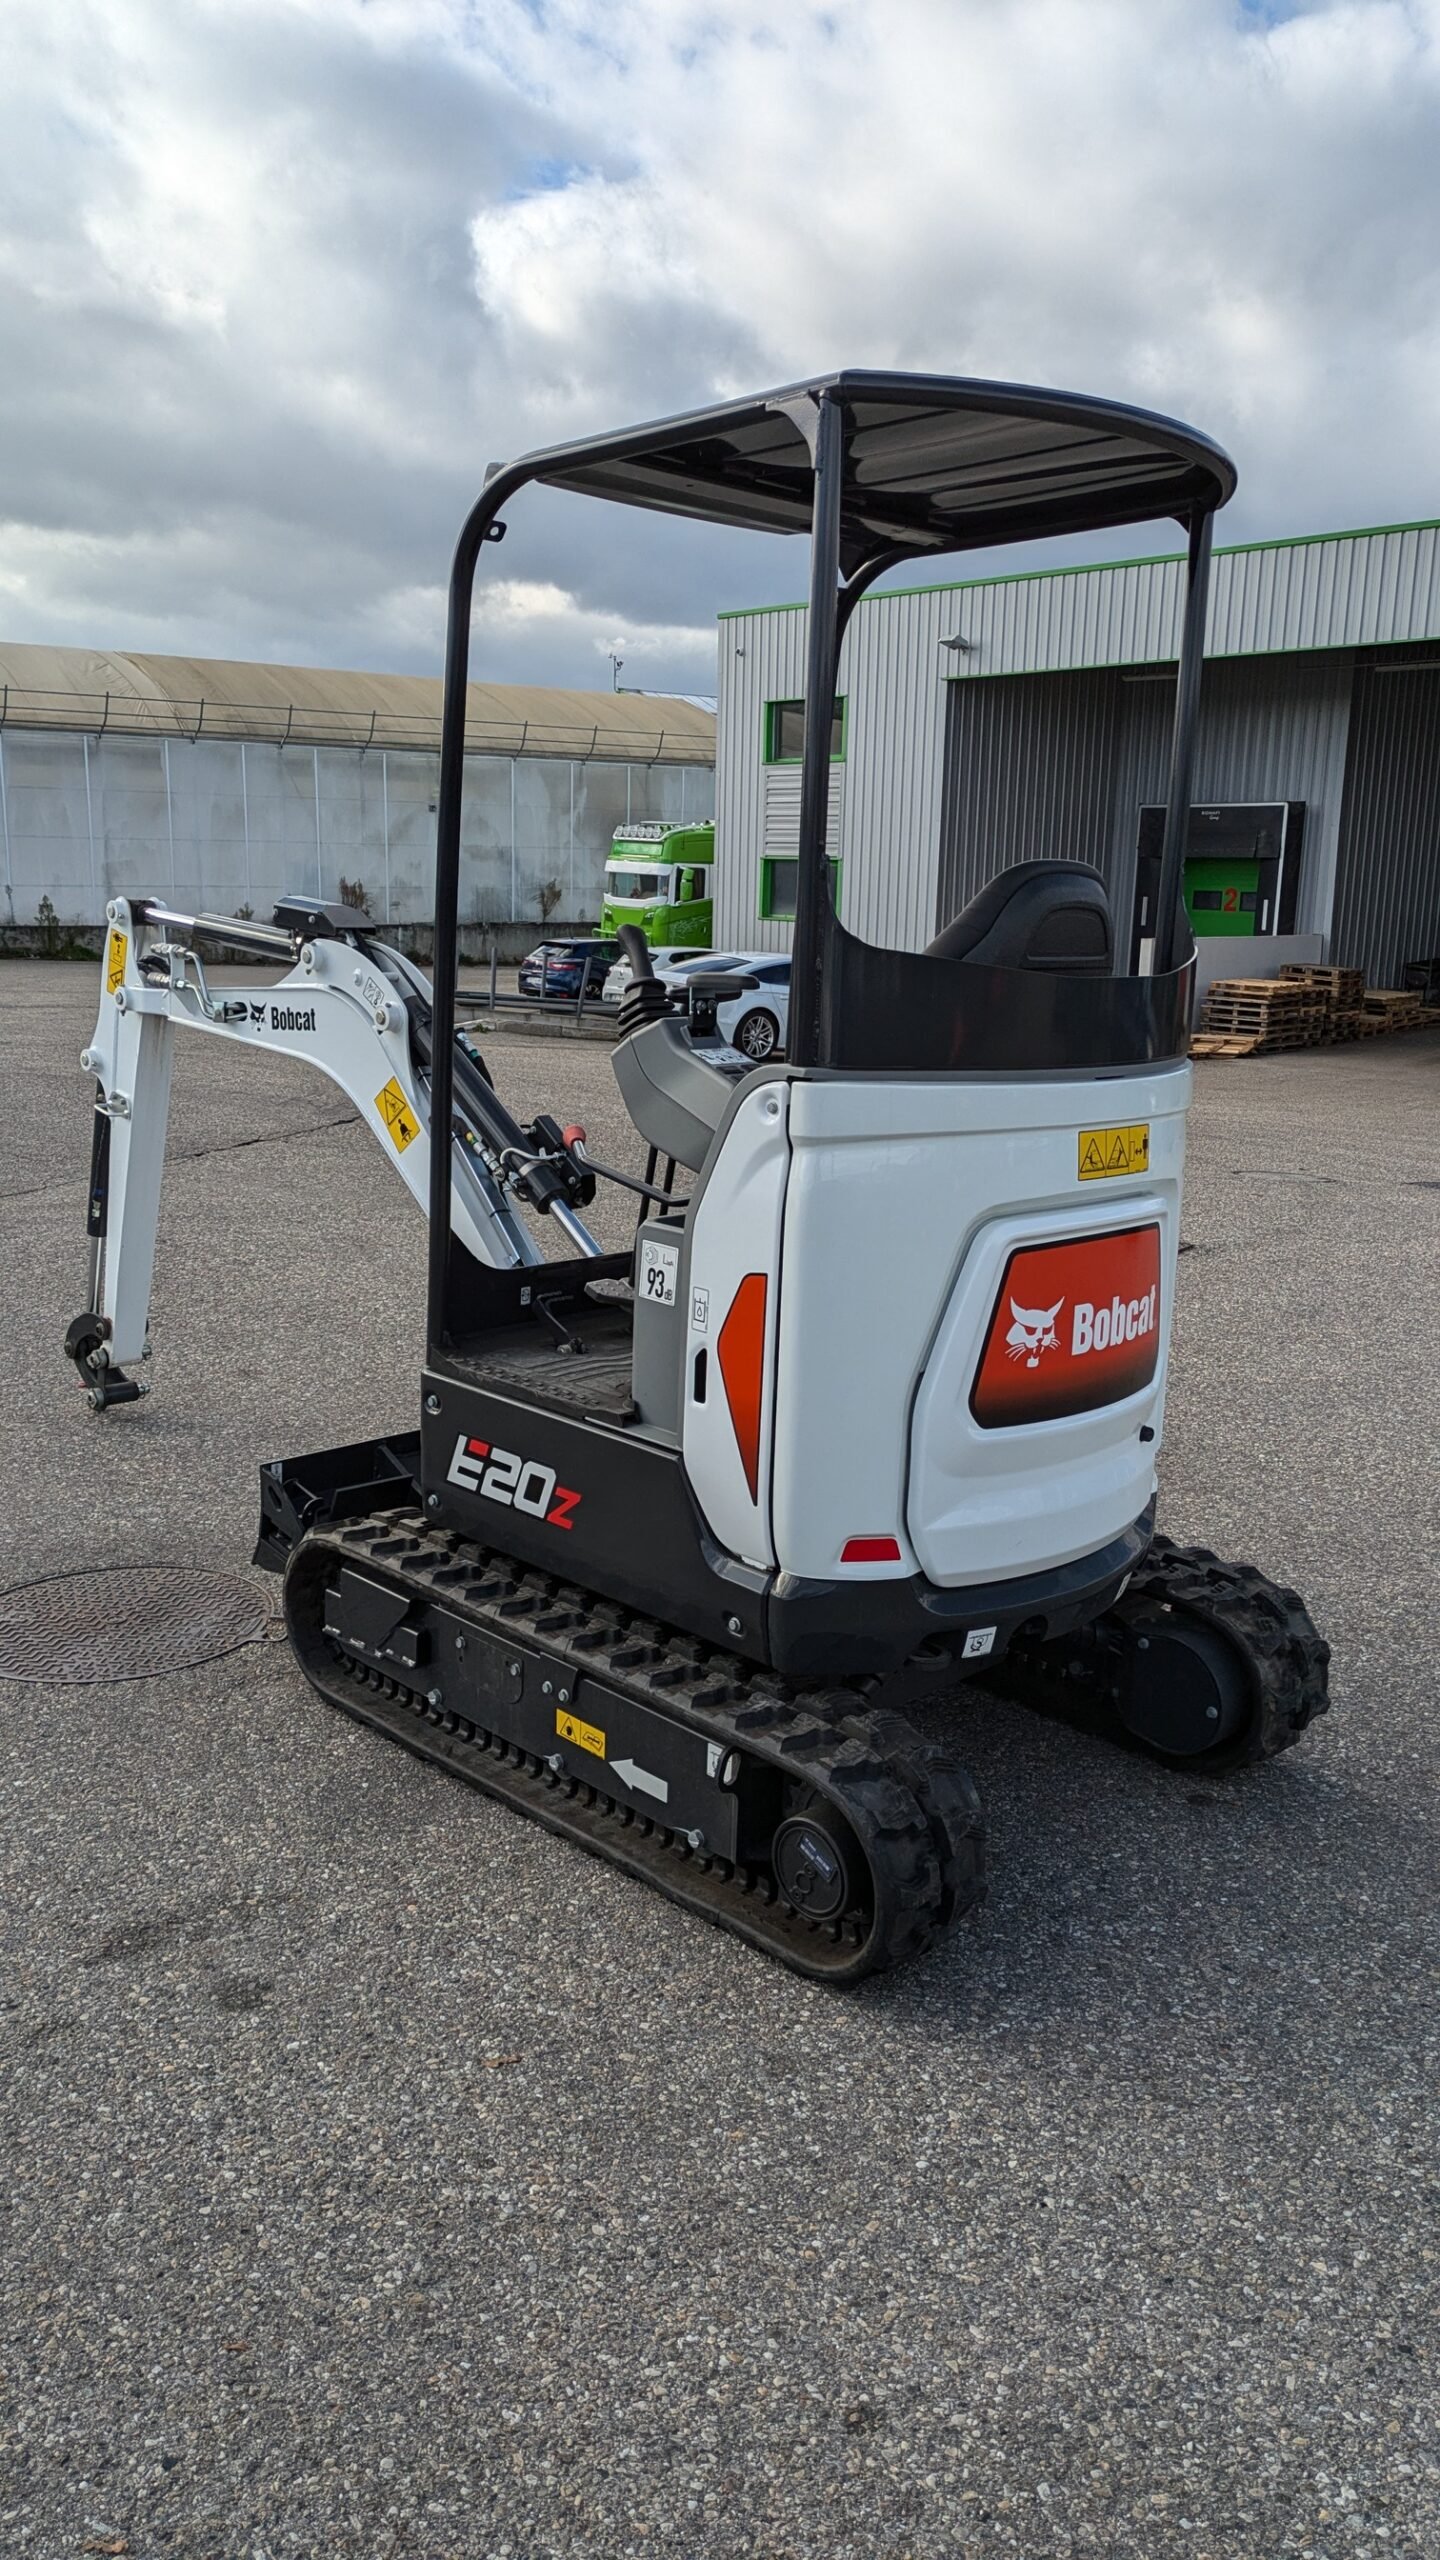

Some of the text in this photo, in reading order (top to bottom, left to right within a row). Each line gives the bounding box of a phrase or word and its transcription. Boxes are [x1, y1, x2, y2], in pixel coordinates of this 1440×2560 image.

[1223, 887, 1238, 912] 2
[271, 1006, 316, 1031] Bobcat
[647, 1267, 665, 1298] 93
[1071, 1284, 1156, 1356] Bobcat
